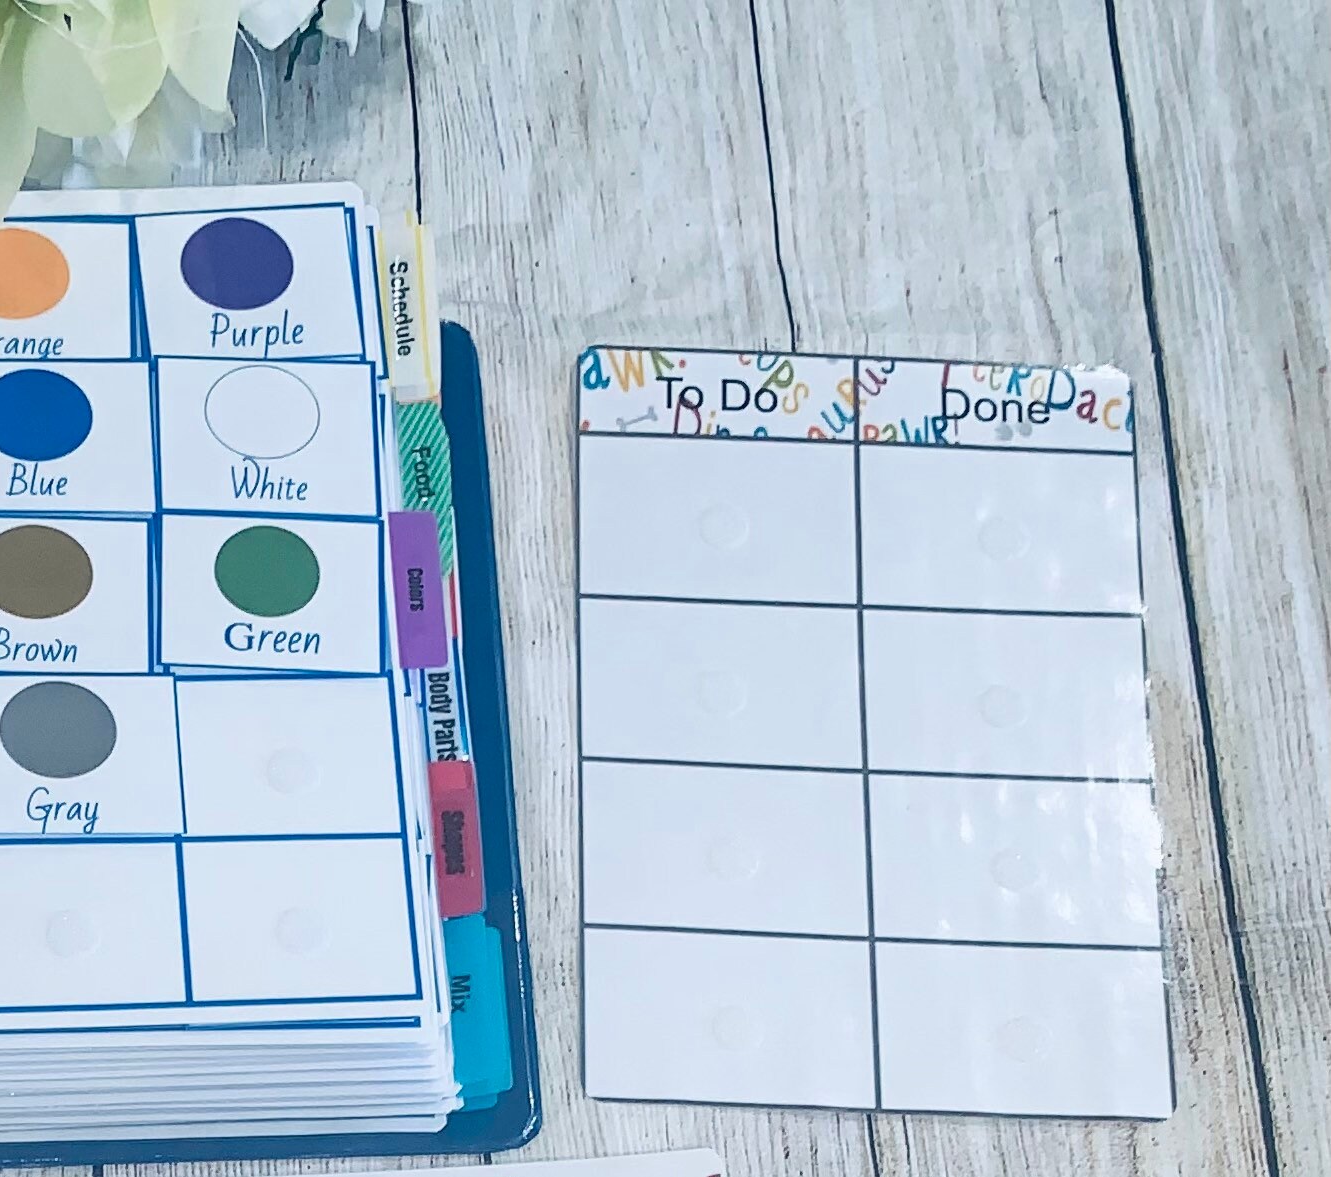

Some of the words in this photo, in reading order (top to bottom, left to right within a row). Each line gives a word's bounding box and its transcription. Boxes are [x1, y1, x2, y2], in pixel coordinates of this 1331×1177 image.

[389, 261, 411, 358] Schedule
[210, 310, 304, 358] Purple
[655, 376, 704, 410] To
[721, 378, 778, 413] Do
[941, 387, 1051, 425] Done
[6, 462, 69, 497] Blue
[230, 456, 310, 501] White
[412, 447, 436, 499] Food
[223, 621, 322, 655] Green
[427, 672, 450, 718] Body
[26, 786, 99, 834] Gray
[451, 974, 471, 1014] Mix
